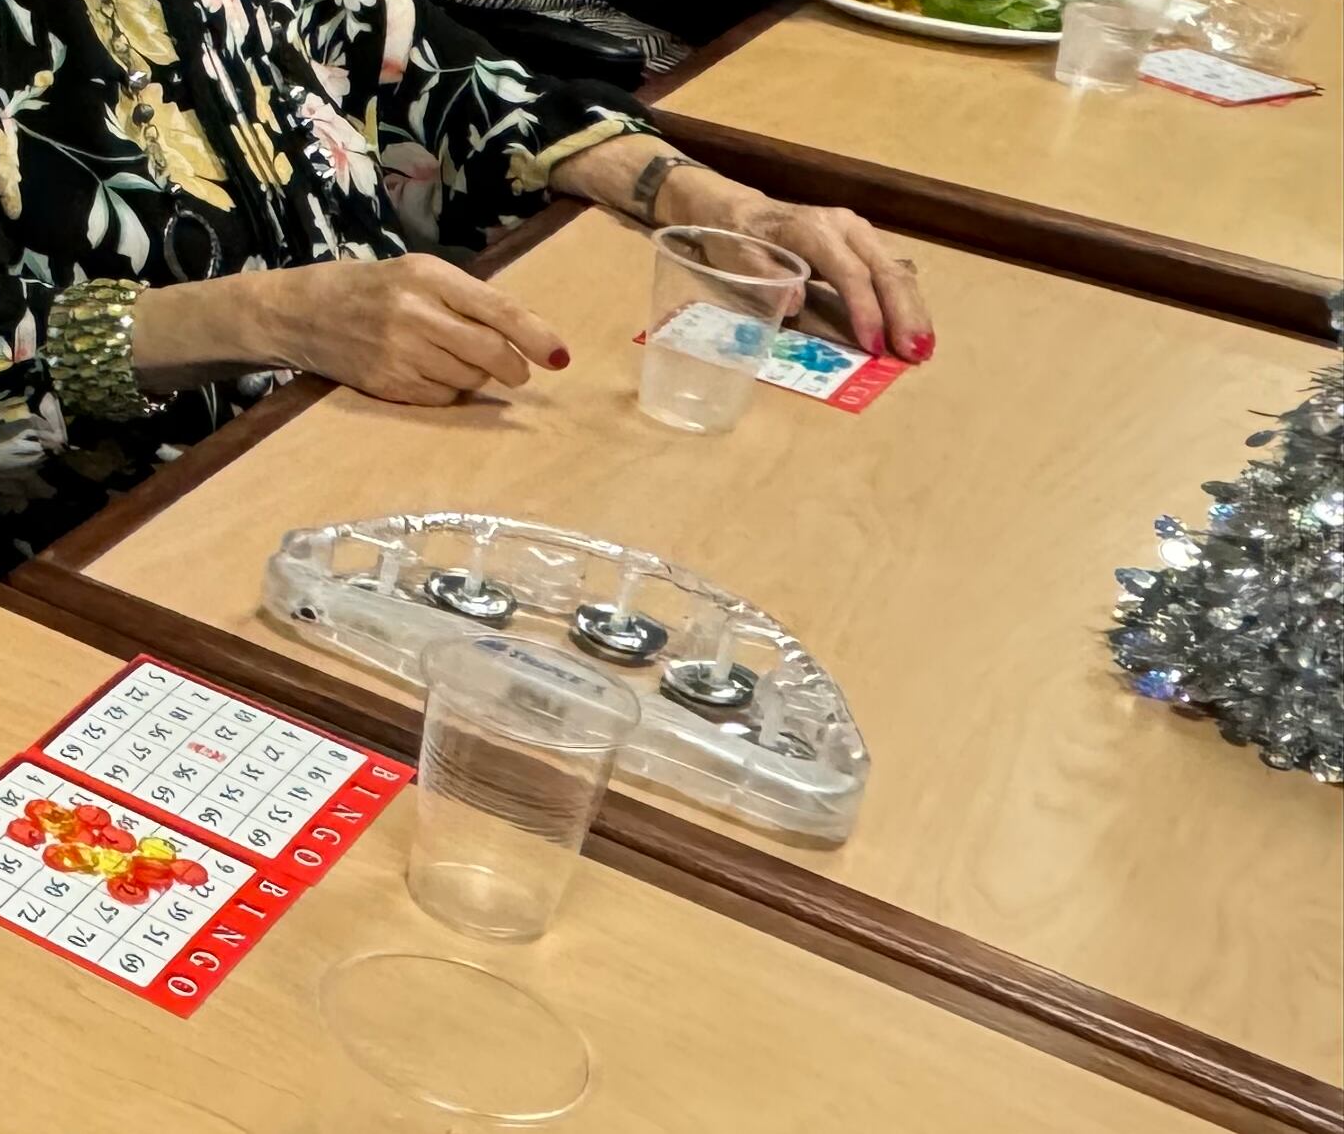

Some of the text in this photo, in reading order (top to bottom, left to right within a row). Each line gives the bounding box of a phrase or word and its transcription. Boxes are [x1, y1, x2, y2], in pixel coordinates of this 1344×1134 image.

[81, 722, 107, 741] 52
[127, 741, 152, 762] 57
[307, 766, 333, 784] 16
[267, 803, 293, 824] 53
[292, 765, 401, 868] BINGO
[216, 859, 236, 874] 9
[16, 901, 47, 924] 72
[93, 900, 120, 925] 57
[167, 900, 194, 922] 39
[66, 926, 97, 948] 70
[142, 923, 171, 947] 51
[167, 878, 290, 998] BINGO
[119, 953, 146, 974] 69
